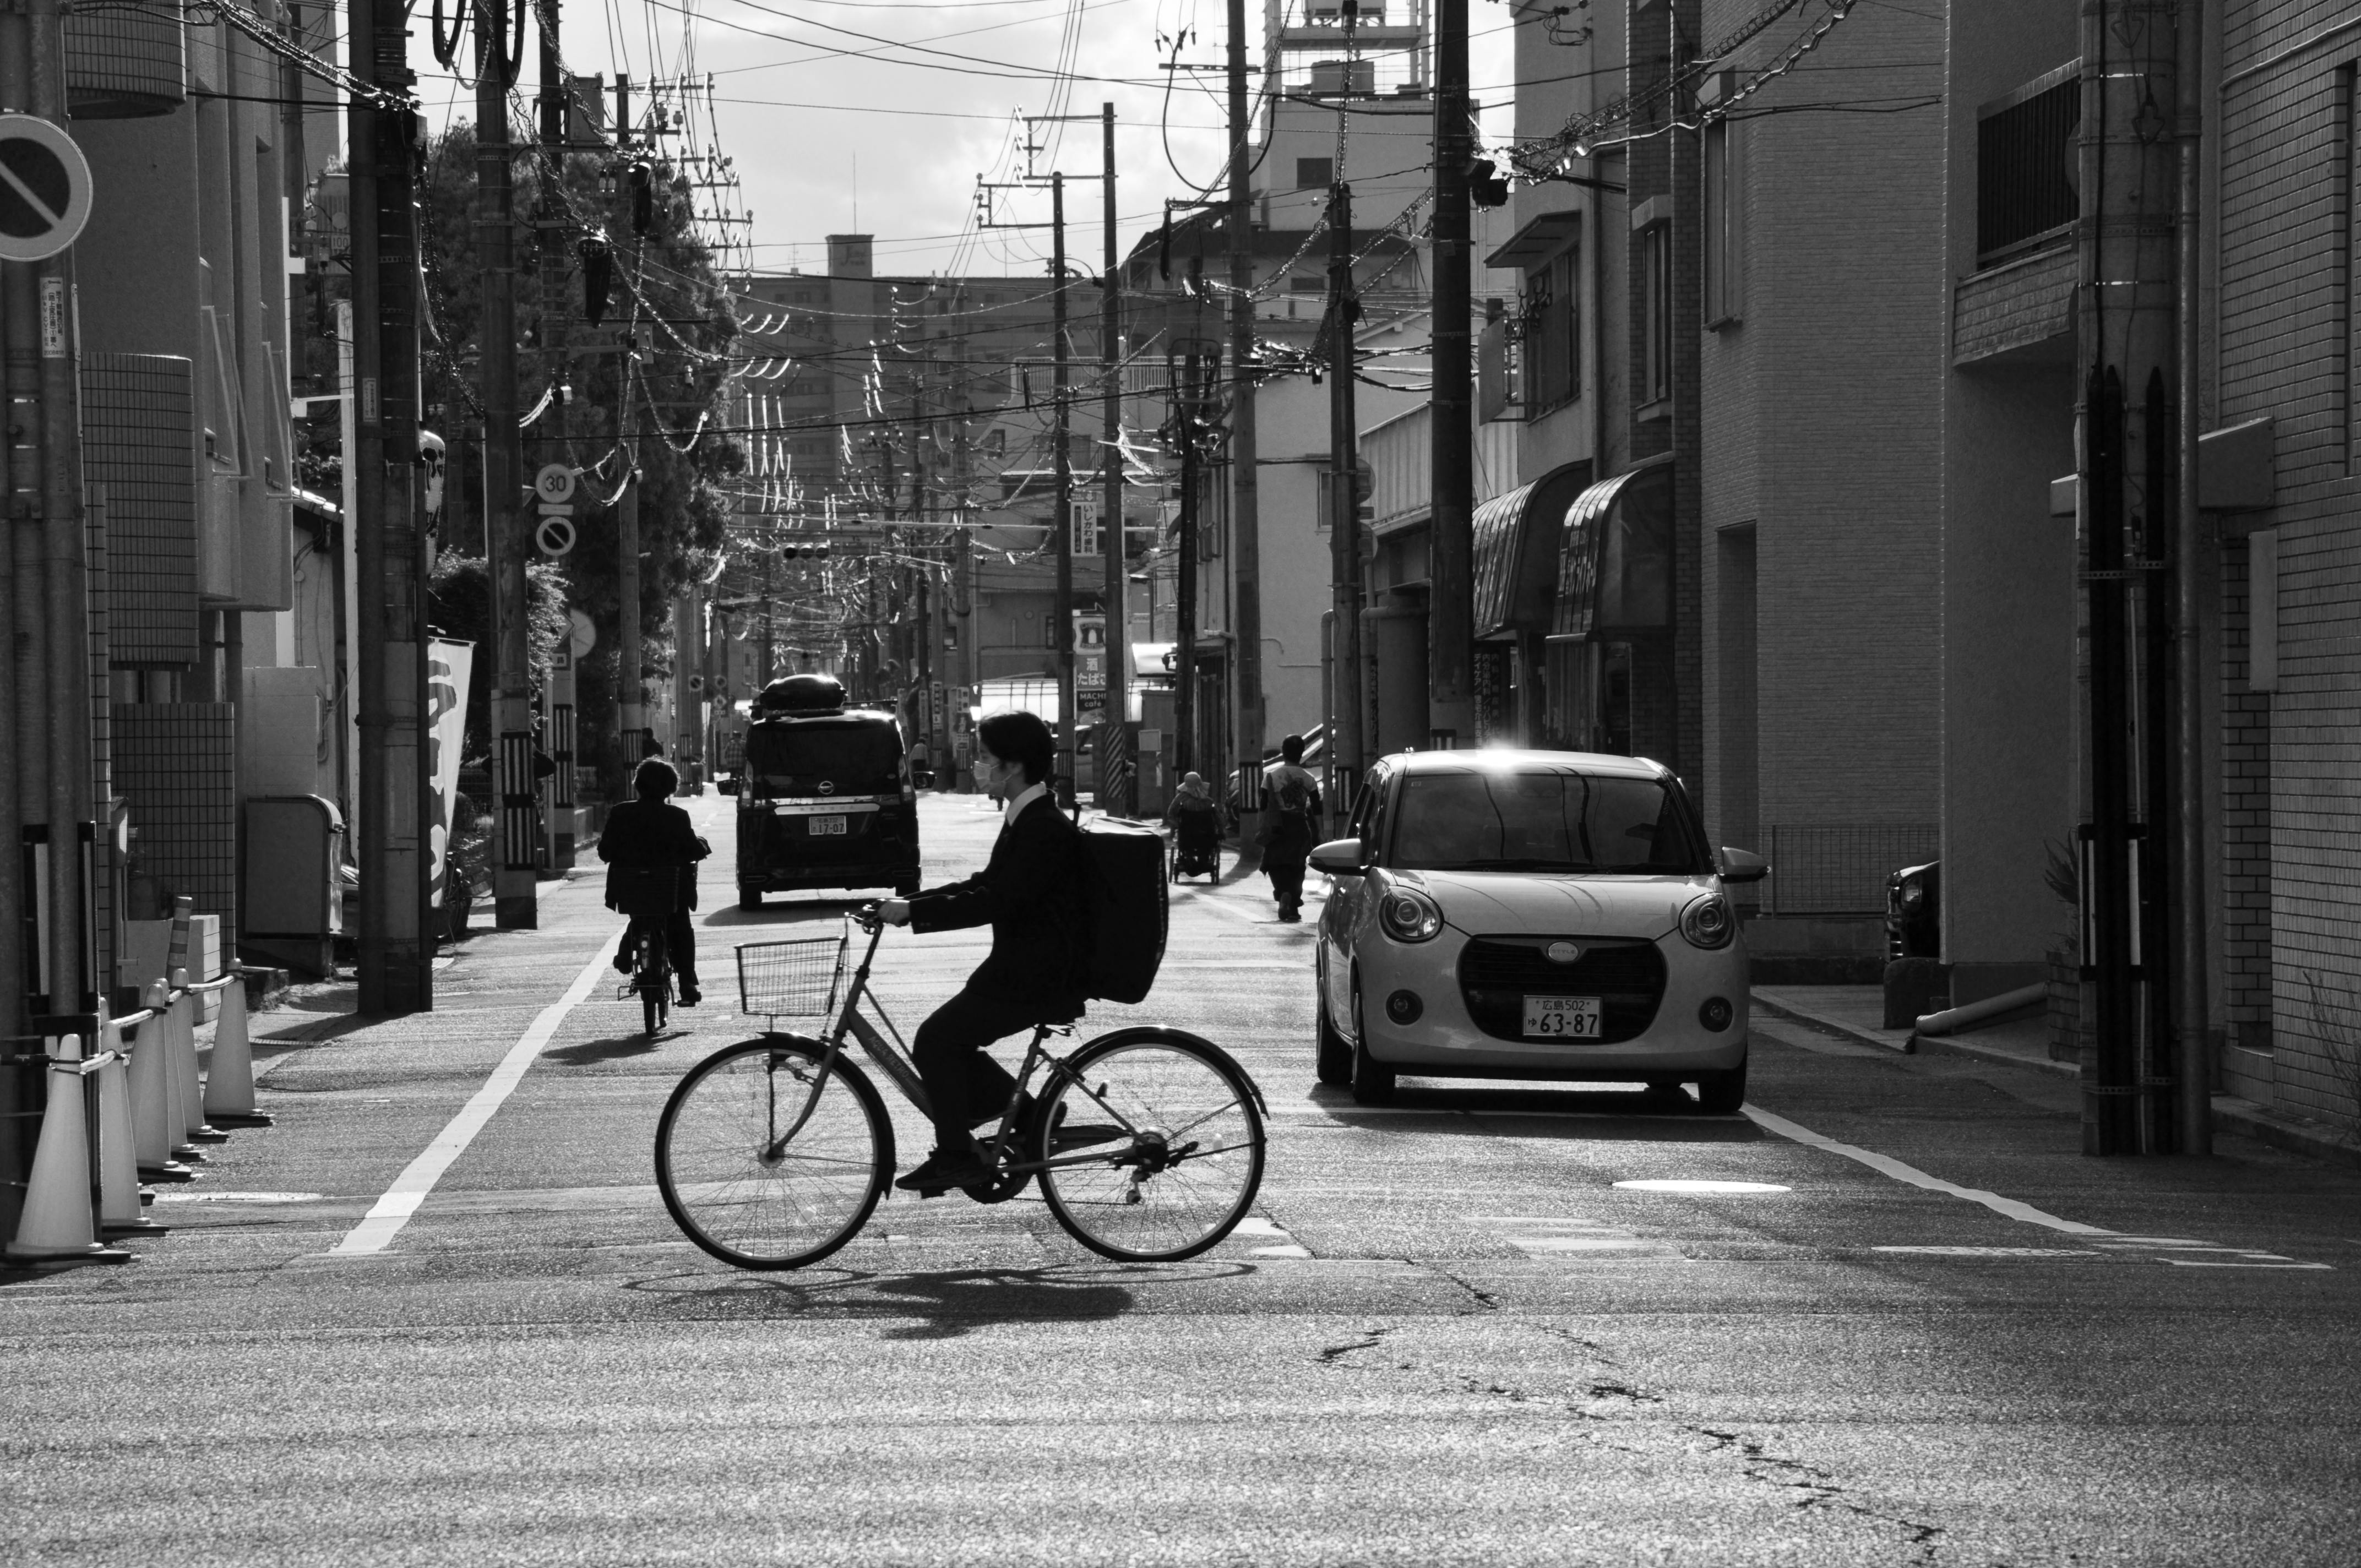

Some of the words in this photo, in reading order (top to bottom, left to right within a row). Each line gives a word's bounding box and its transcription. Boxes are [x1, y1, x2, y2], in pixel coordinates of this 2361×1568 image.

[333, 237, 348, 248] 100
[545, 475, 567, 493] 30
[1083, 504, 1094, 554] いしかわ歯科
[1086, 658, 1098, 671] 酒
[819, 824, 844, 834] 17-07
[1528, 1017, 1537, 1027] ゆ
[1540, 1013, 1597, 1033] 63-87
